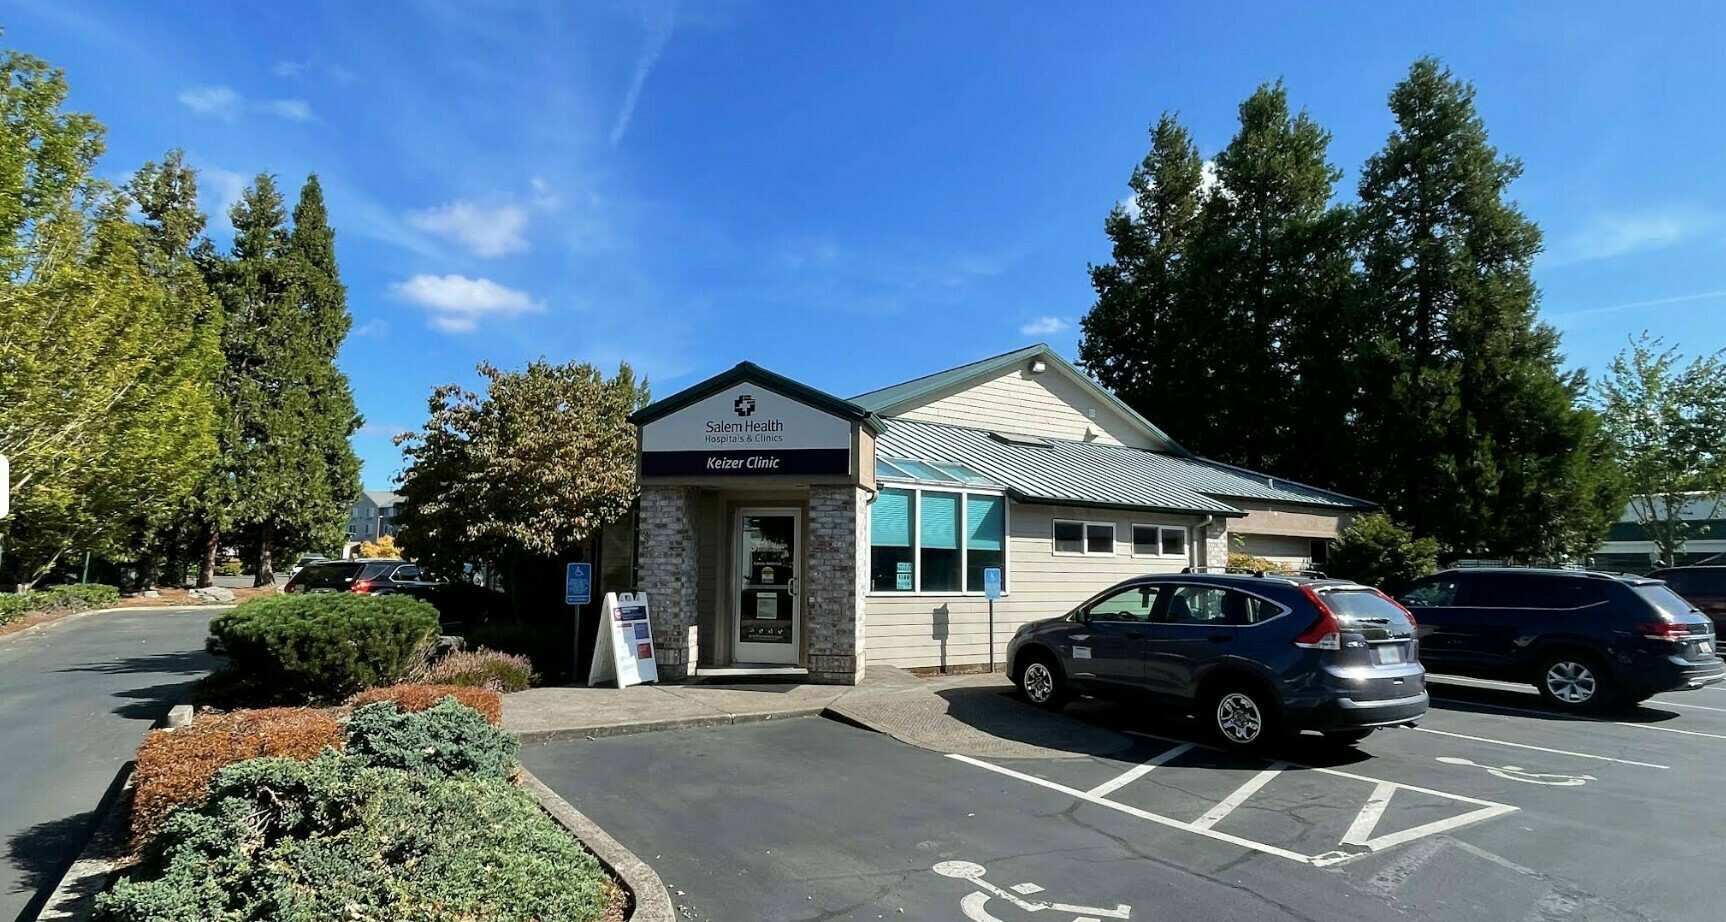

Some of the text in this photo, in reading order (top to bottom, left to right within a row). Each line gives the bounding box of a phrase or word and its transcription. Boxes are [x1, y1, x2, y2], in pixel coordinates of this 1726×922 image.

[705, 419, 783, 433] Salem Health
[705, 434, 783, 444] Hospitals & Clinics
[706, 456, 780, 470] Keizer Clinic
